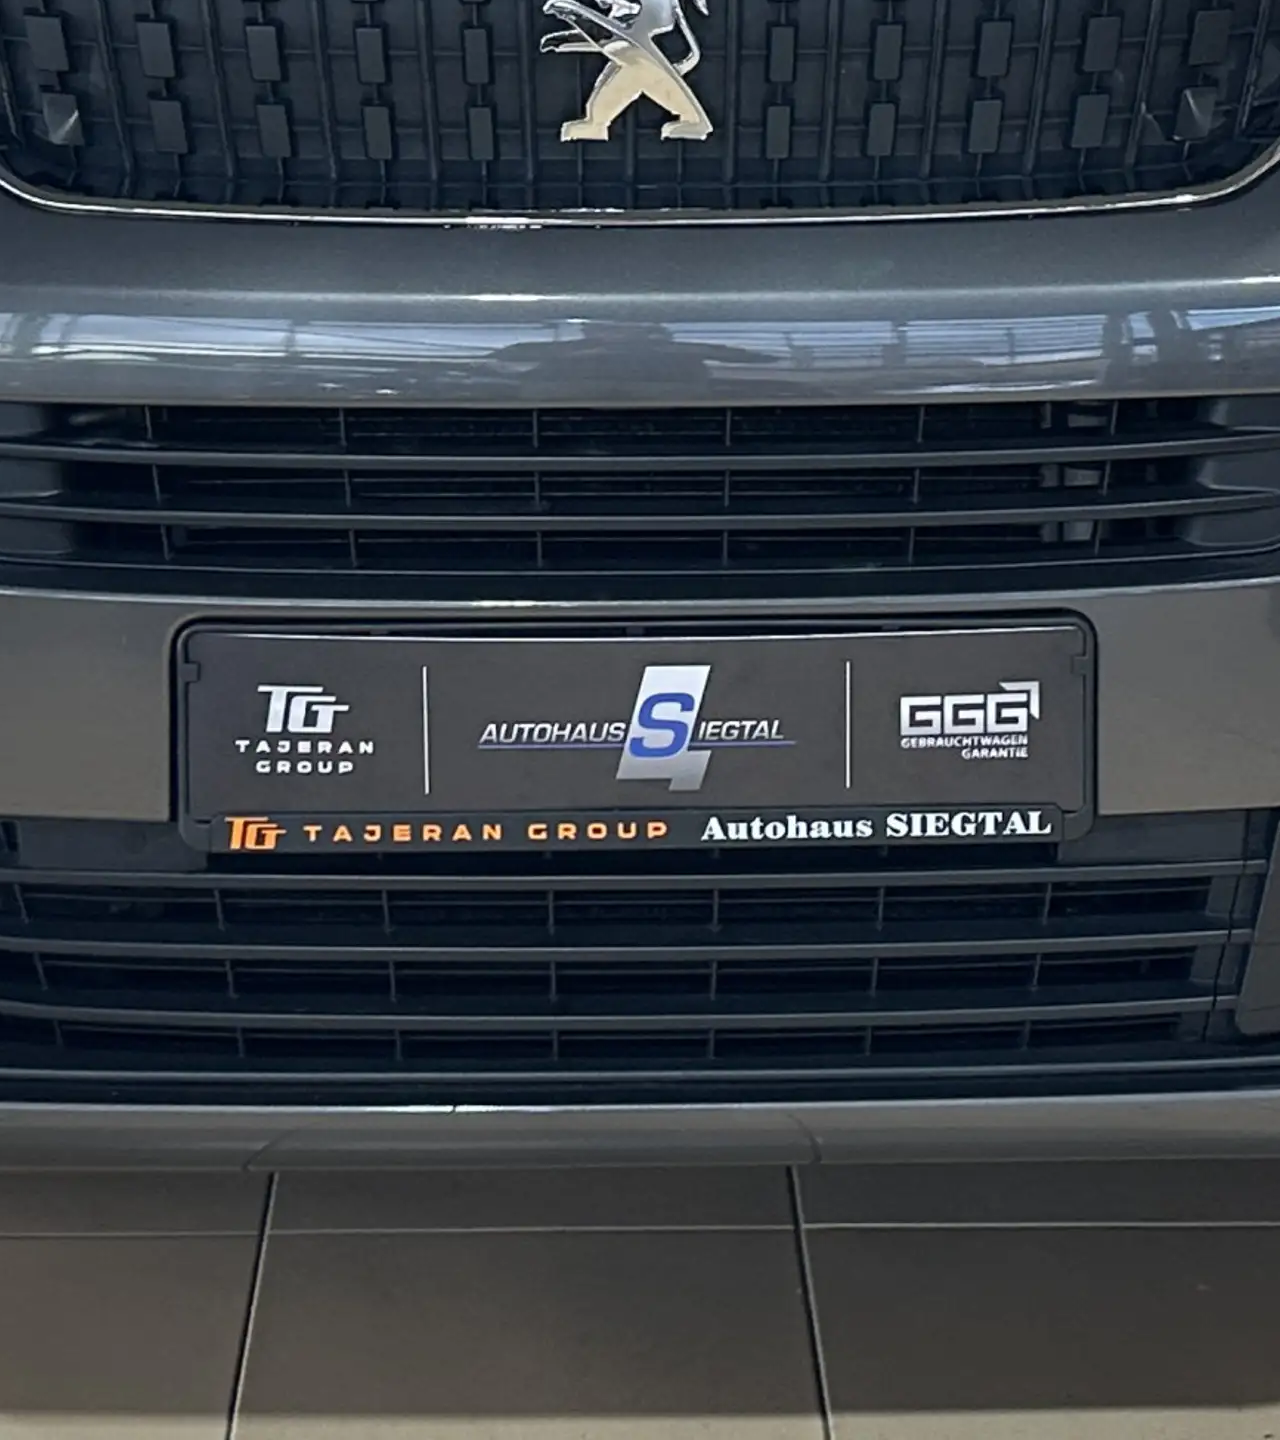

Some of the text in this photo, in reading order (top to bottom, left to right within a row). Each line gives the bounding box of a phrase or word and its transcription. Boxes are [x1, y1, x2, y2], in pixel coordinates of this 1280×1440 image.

[900, 691, 1029, 737] GGG
[479, 721, 626, 744] AUTOHAUS
[234, 739, 375, 755] TAJERAN
[900, 733, 1029, 749] GEBRAUCHTWAGEN
[961, 747, 1029, 760] GARANTIE
[255, 760, 354, 775] GROUP
[303, 823, 503, 843] TAJERAN
[527, 822, 669, 840] GROUP
[701, 816, 874, 841] Autohaus
[886, 810, 1052, 837] SIEGTAL
